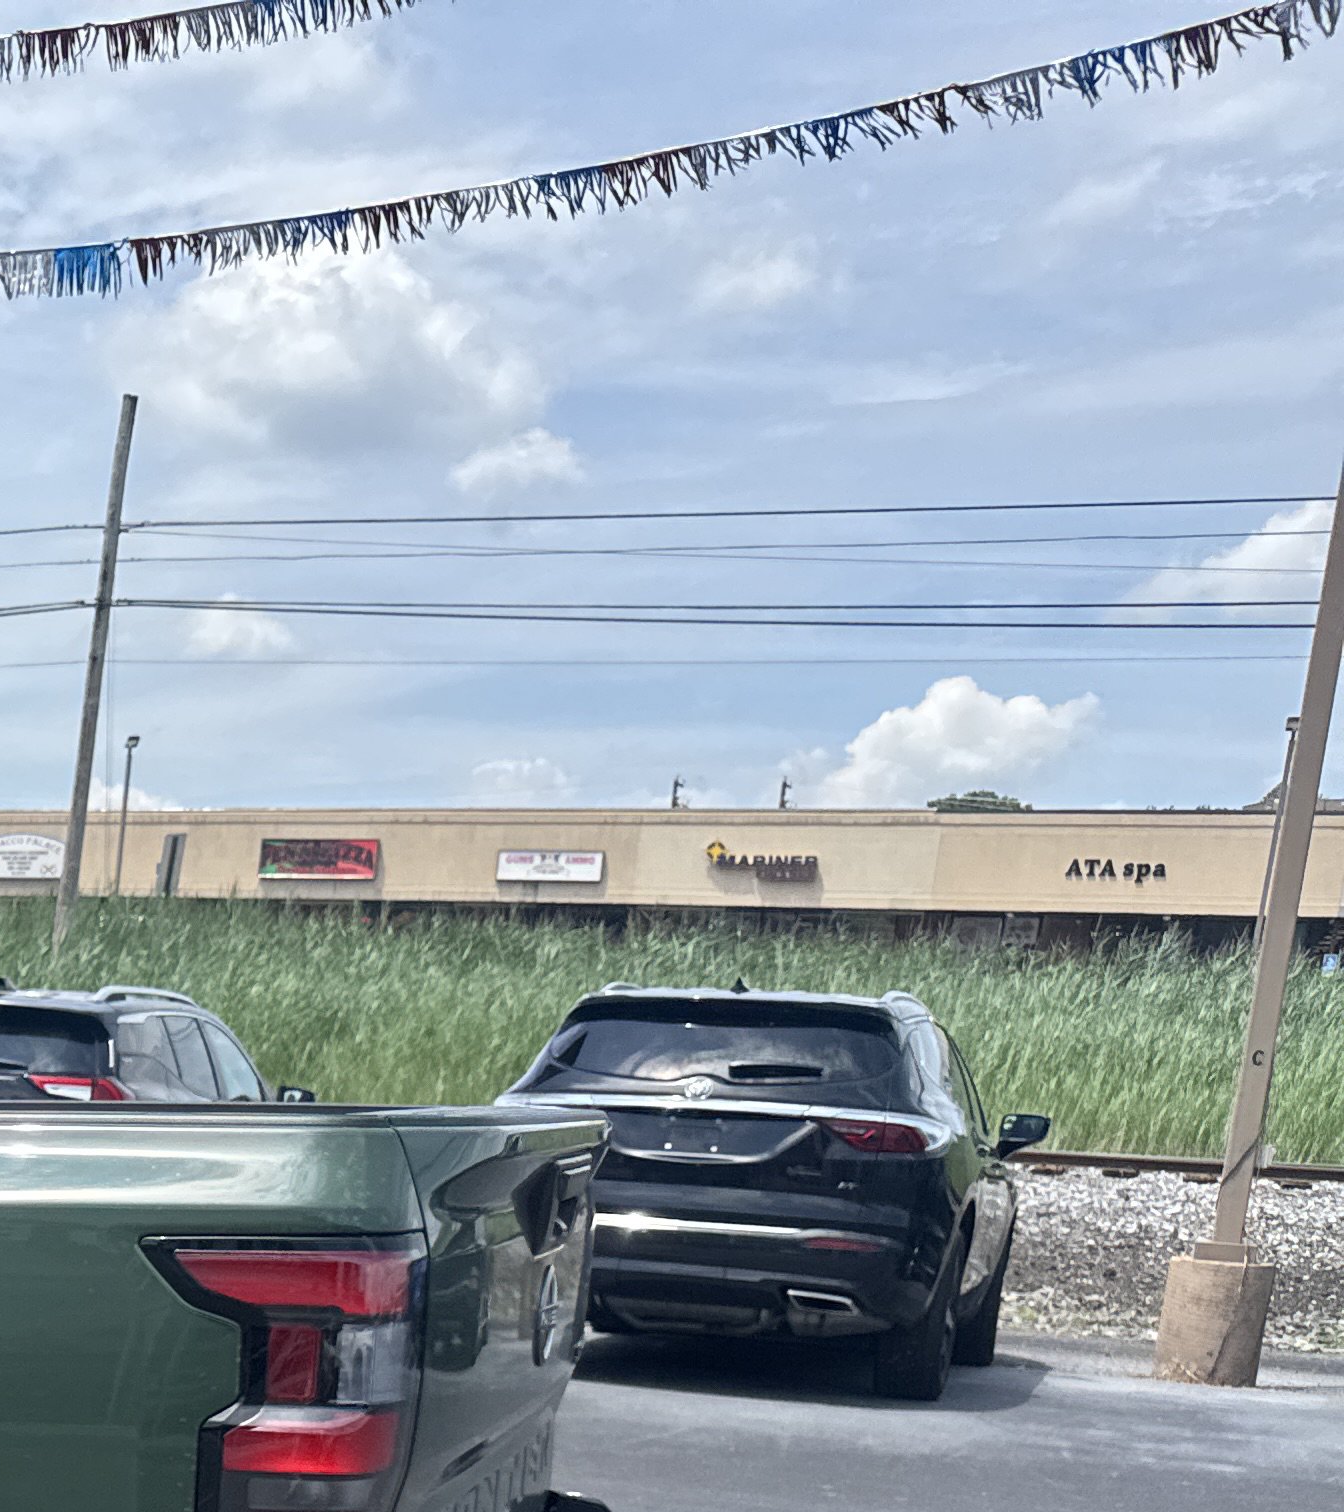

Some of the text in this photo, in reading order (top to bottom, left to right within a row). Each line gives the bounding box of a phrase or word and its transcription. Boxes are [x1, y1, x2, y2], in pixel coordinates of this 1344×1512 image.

[716, 854, 818, 869] MARINER
[1065, 859, 1166, 884] ATA spa
